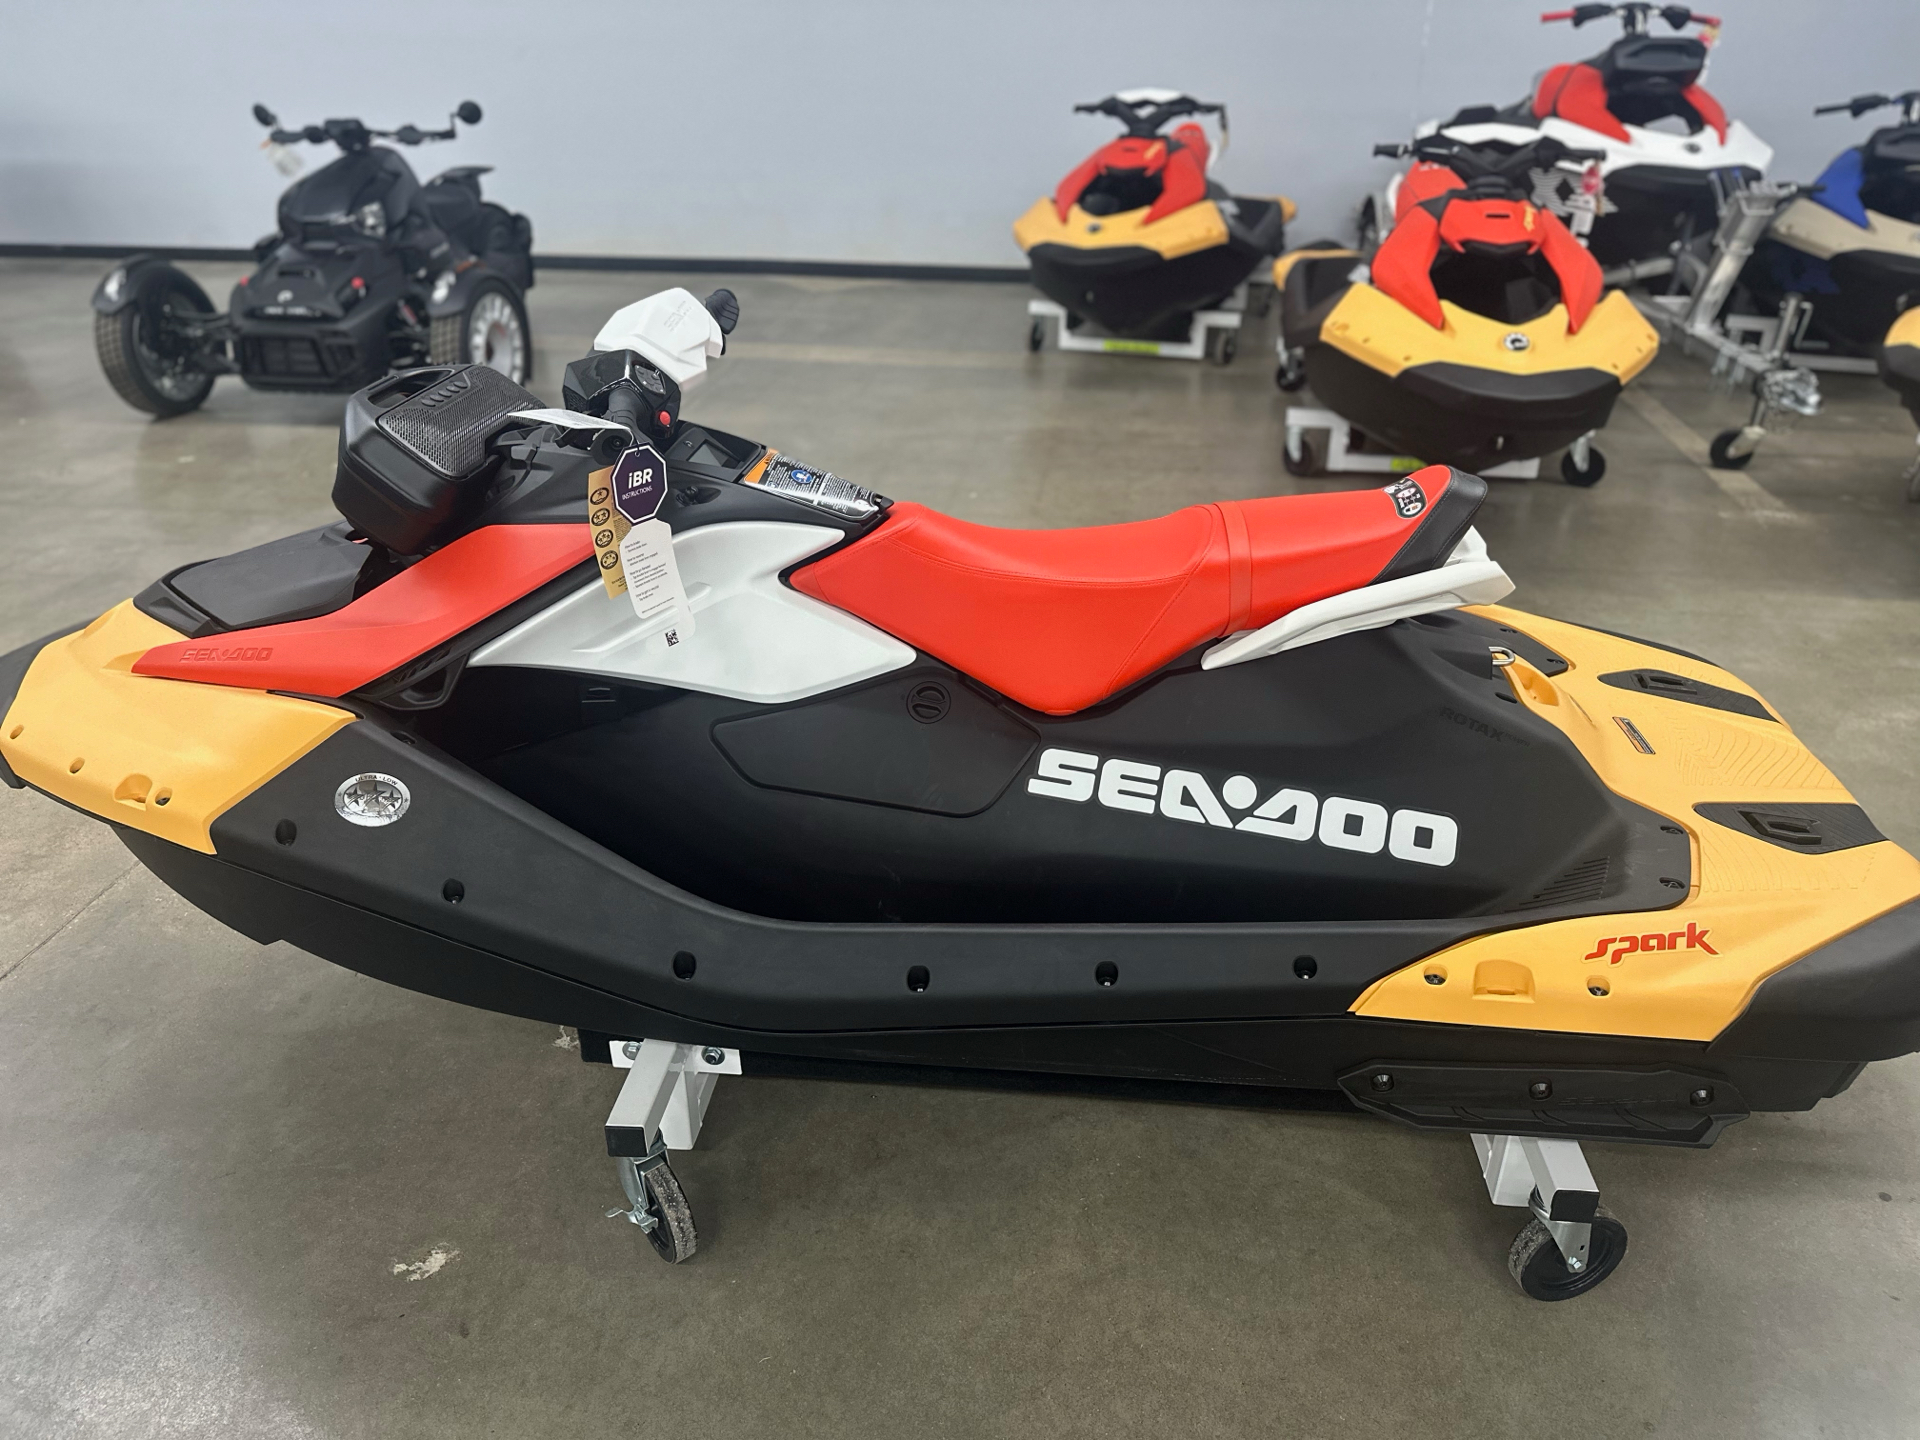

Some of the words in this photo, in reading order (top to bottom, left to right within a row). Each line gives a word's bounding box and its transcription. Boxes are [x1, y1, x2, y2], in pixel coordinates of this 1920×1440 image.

[628, 468, 653, 489] iBR
[622, 485, 653, 501] INSTRUCTIONS
[1439, 707, 1505, 743] ROTAX
[354, 774, 378, 782] ULTRA
